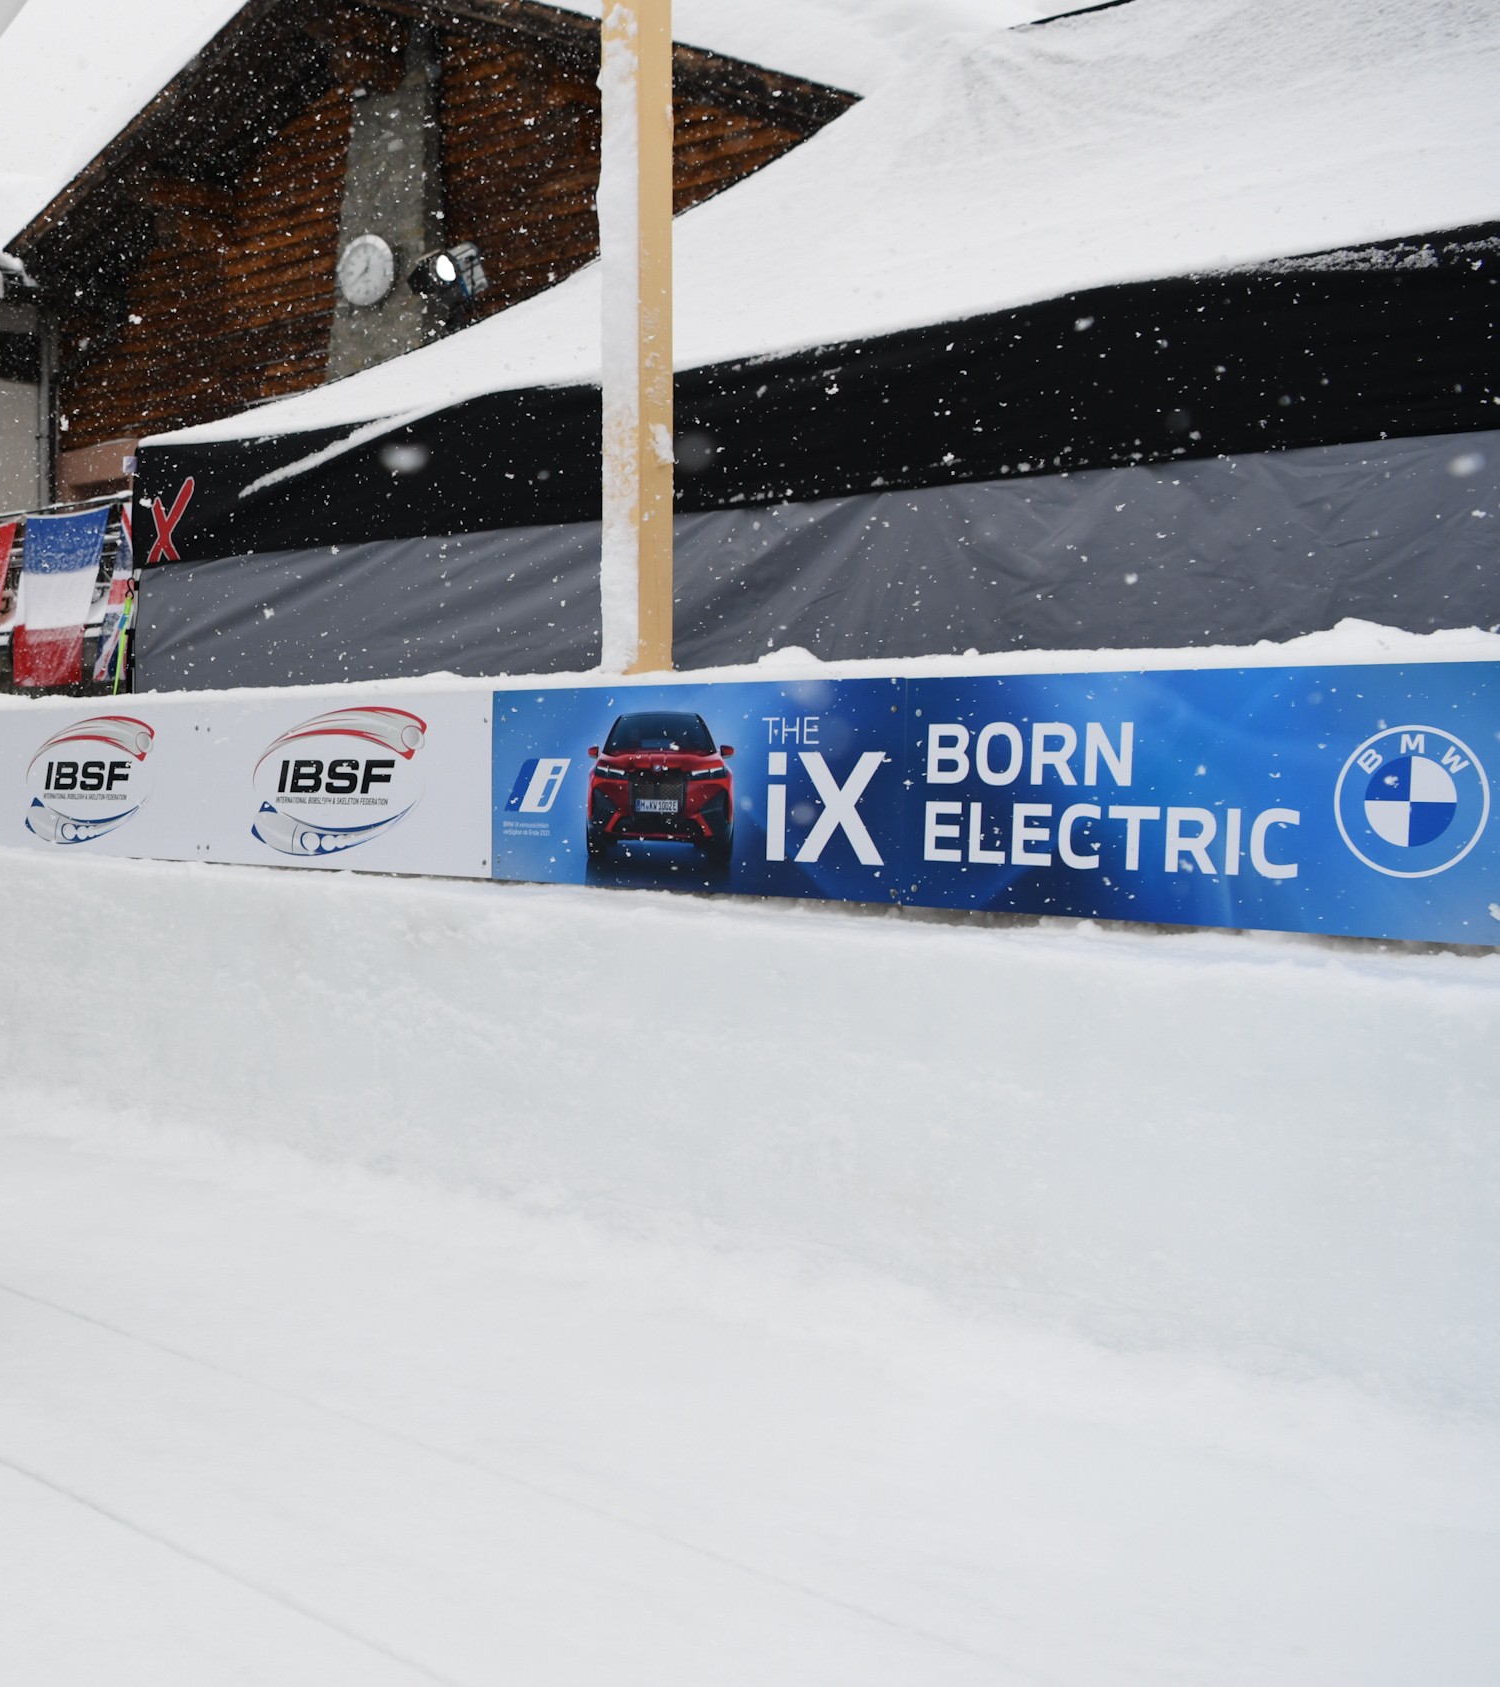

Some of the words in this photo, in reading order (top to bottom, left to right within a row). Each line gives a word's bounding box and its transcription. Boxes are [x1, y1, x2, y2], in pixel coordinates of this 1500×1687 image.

[762, 716, 820, 745] THE
[926, 721, 1134, 787] BORN
[1356, 733, 1470, 774] BMW
[44, 761, 132, 791] IBSF
[277, 759, 396, 794] IBSF
[276, 796, 307, 804] INTERNATIONAL
[336, 797, 359, 805] SKELETON
[360, 797, 388, 806] FEDERATION
[765, 750, 887, 866] iX
[924, 800, 1301, 879] ELECTRIC
